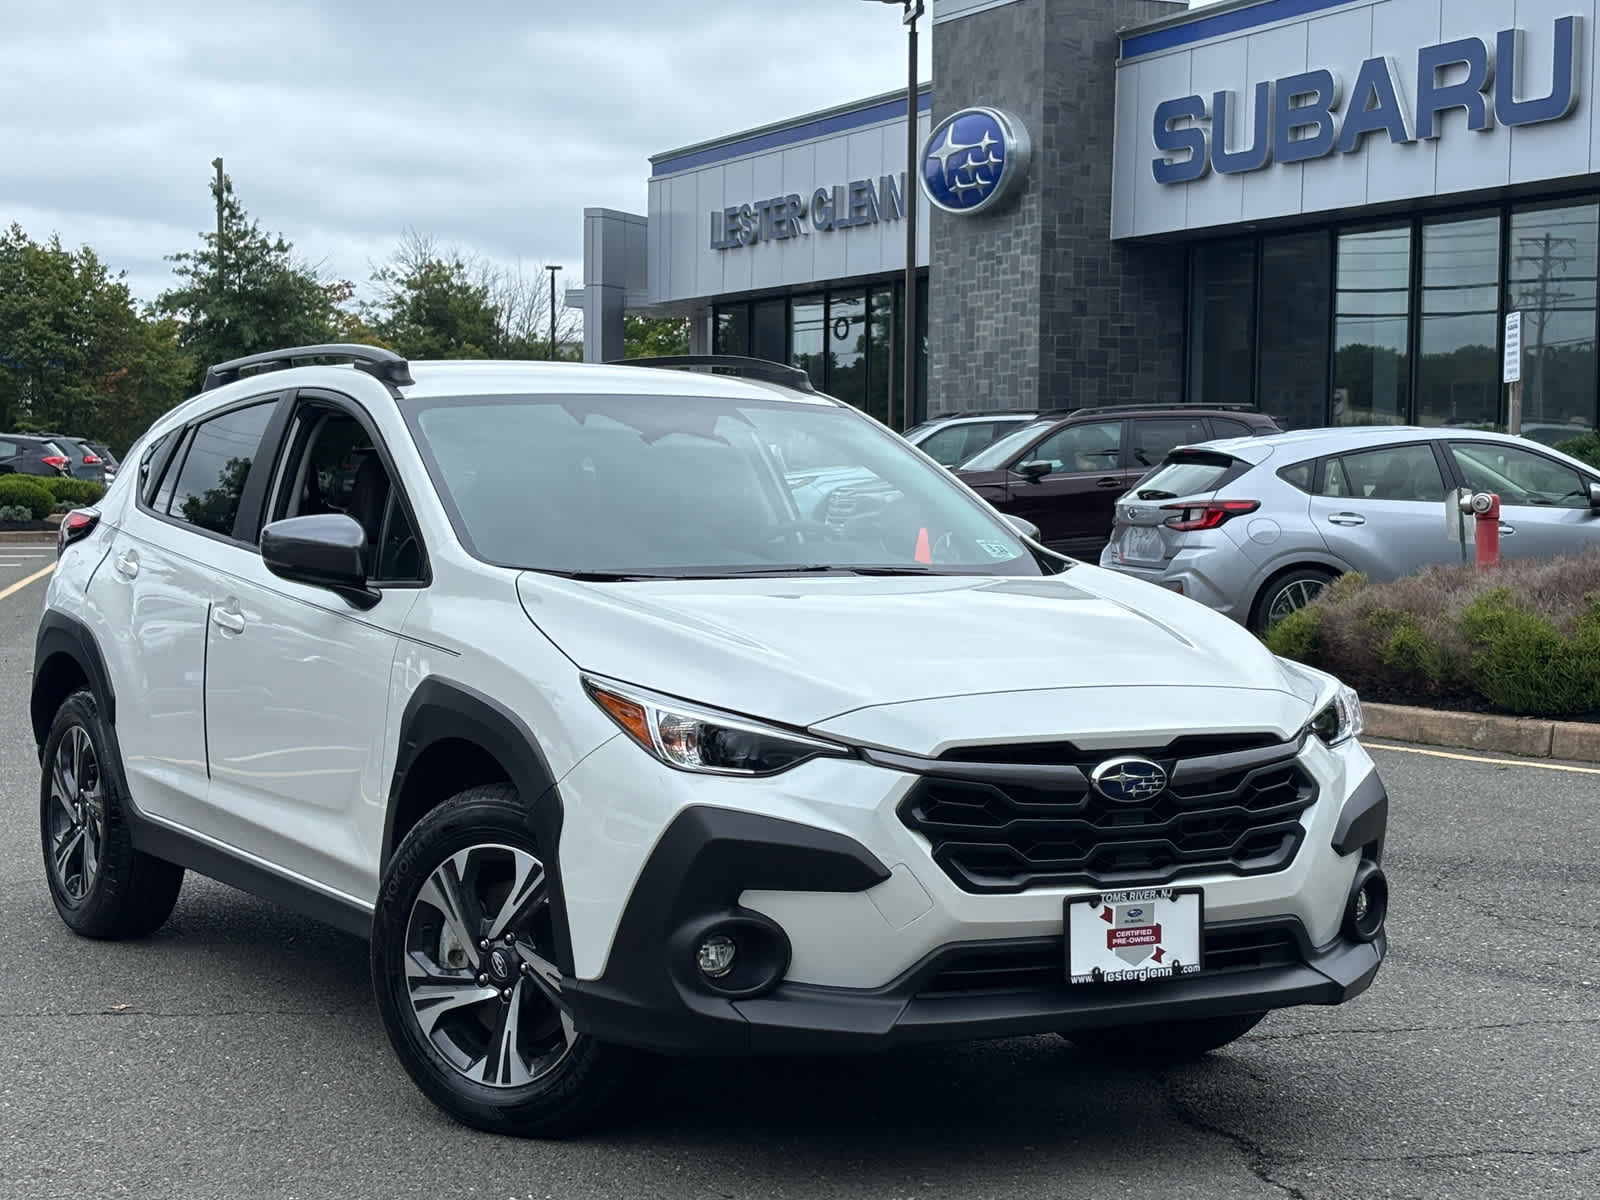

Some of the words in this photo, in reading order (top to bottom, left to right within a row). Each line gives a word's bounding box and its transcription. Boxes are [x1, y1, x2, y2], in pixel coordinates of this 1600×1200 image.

[1152, 15, 1583, 184] SUBARU
[711, 193, 808, 249] LESTER
[811, 172, 907, 232] GLENN
[1101, 892, 1127, 903] TOMS
[1160, 888, 1173, 898] NJ
[1112, 936, 1156, 945] PRE-OWNED
[1116, 929, 1153, 938] CERTIFIED
[1103, 968, 1172, 982] lesterglenn
